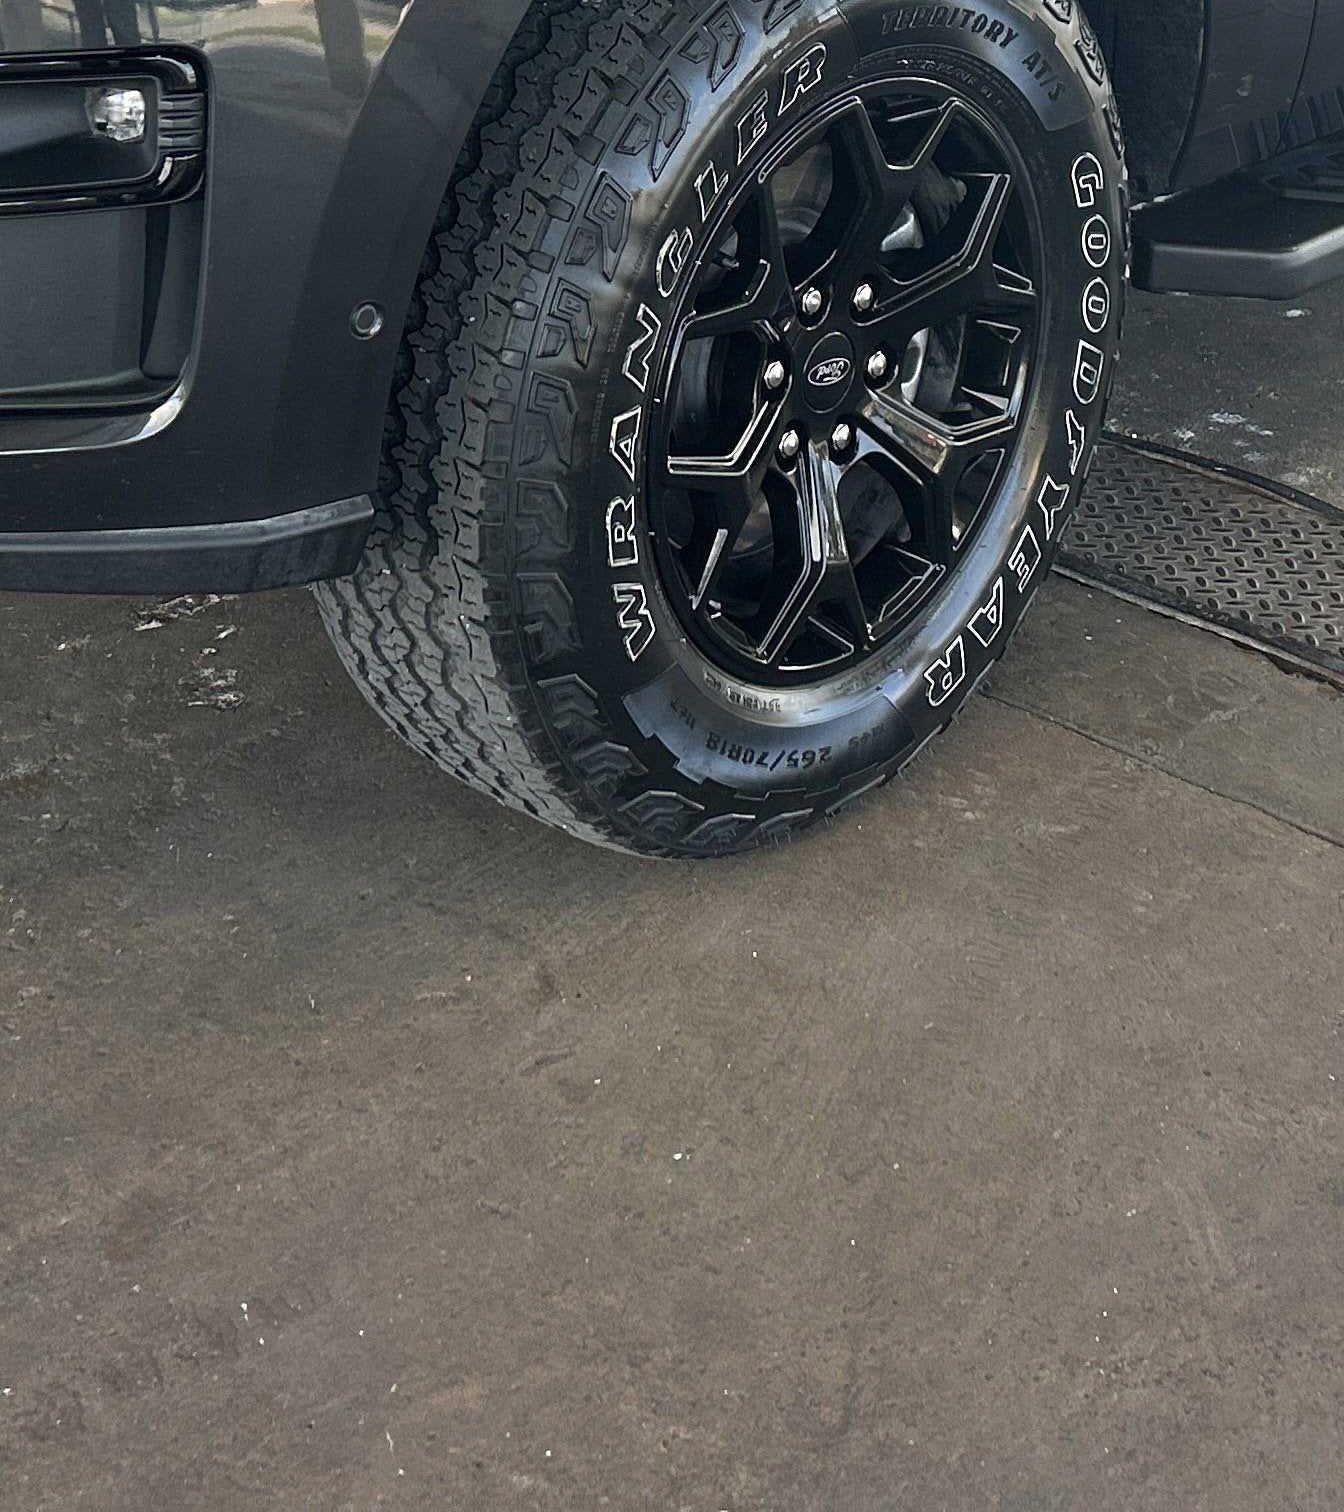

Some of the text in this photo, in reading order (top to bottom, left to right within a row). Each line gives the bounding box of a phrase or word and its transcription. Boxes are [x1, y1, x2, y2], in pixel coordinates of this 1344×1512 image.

[880, 4, 1020, 49] TERRITORY
[605, 39, 829, 663] WRANGLER
[815, 360, 845, 382] Ford
[925, 151, 1114, 713] GOODYEAR
[705, 730, 833, 772] 265/70R18
